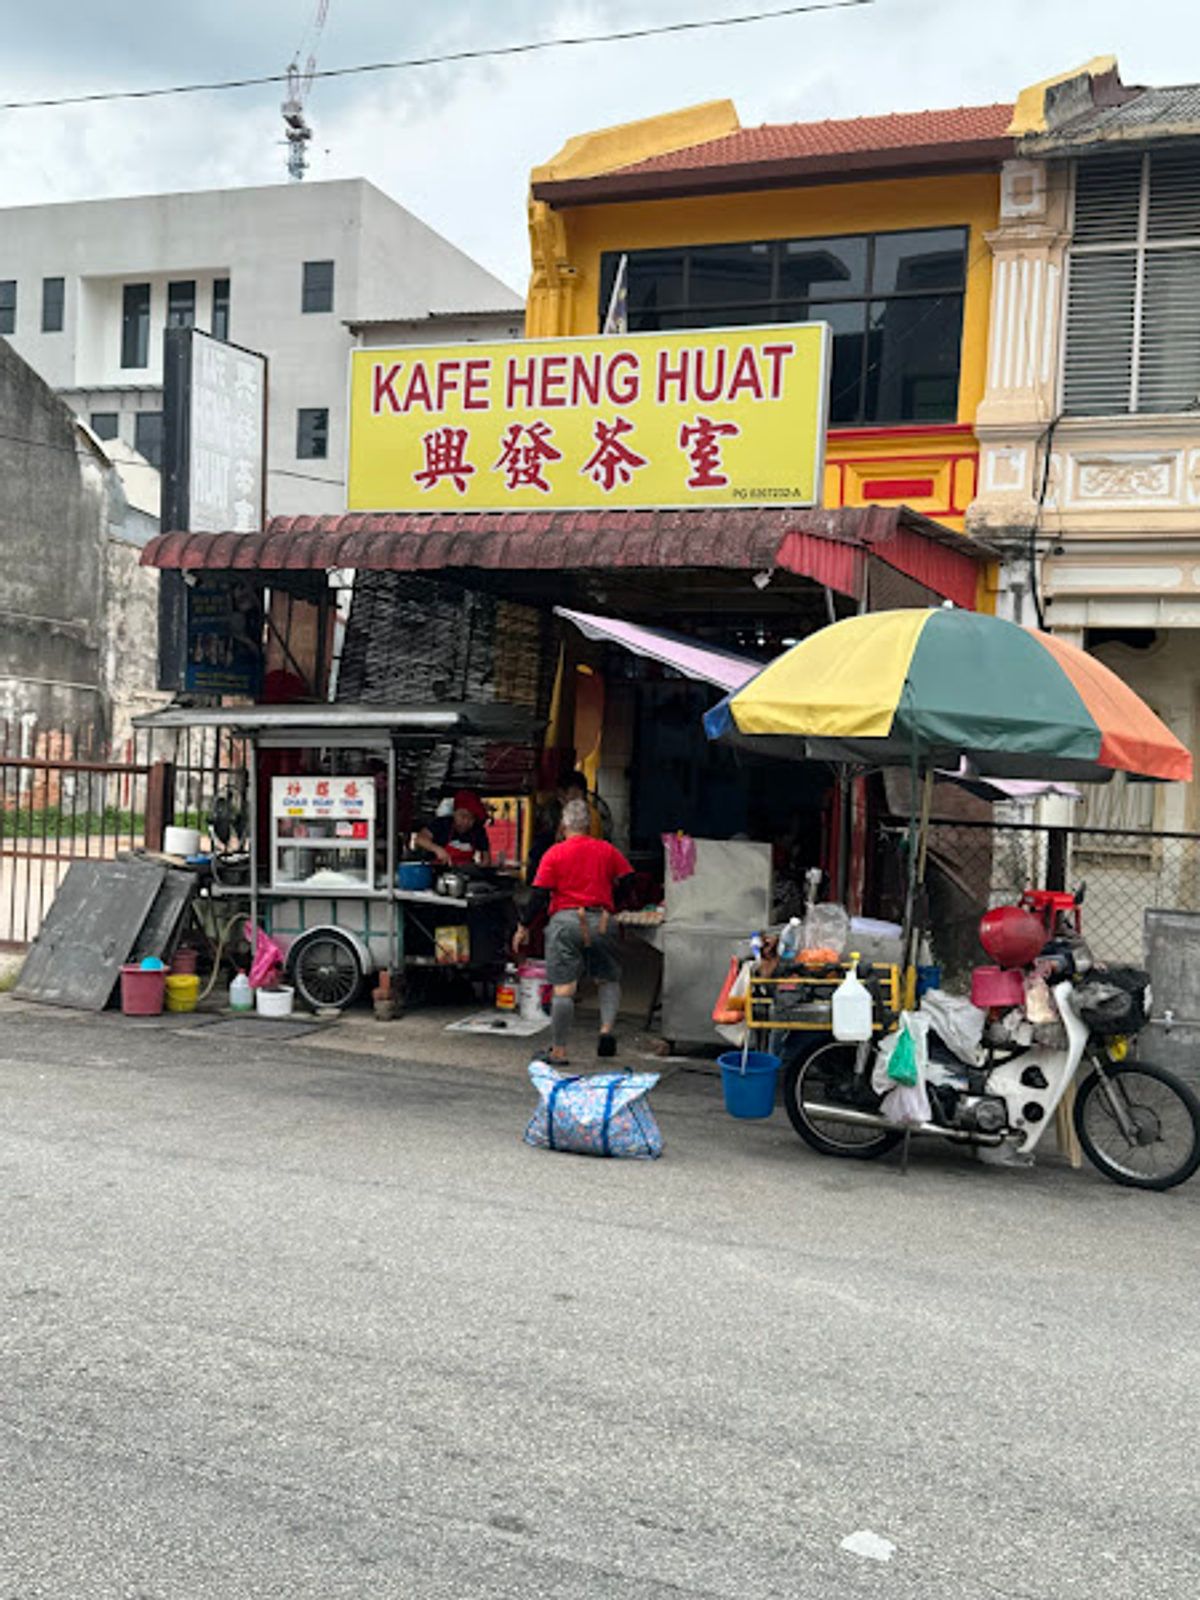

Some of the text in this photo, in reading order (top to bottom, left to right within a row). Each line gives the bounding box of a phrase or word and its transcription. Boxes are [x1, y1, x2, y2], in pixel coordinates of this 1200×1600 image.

[372, 343, 794, 414] KAFE HENG HUAT
[413, 416, 740, 493] 興發茶室
